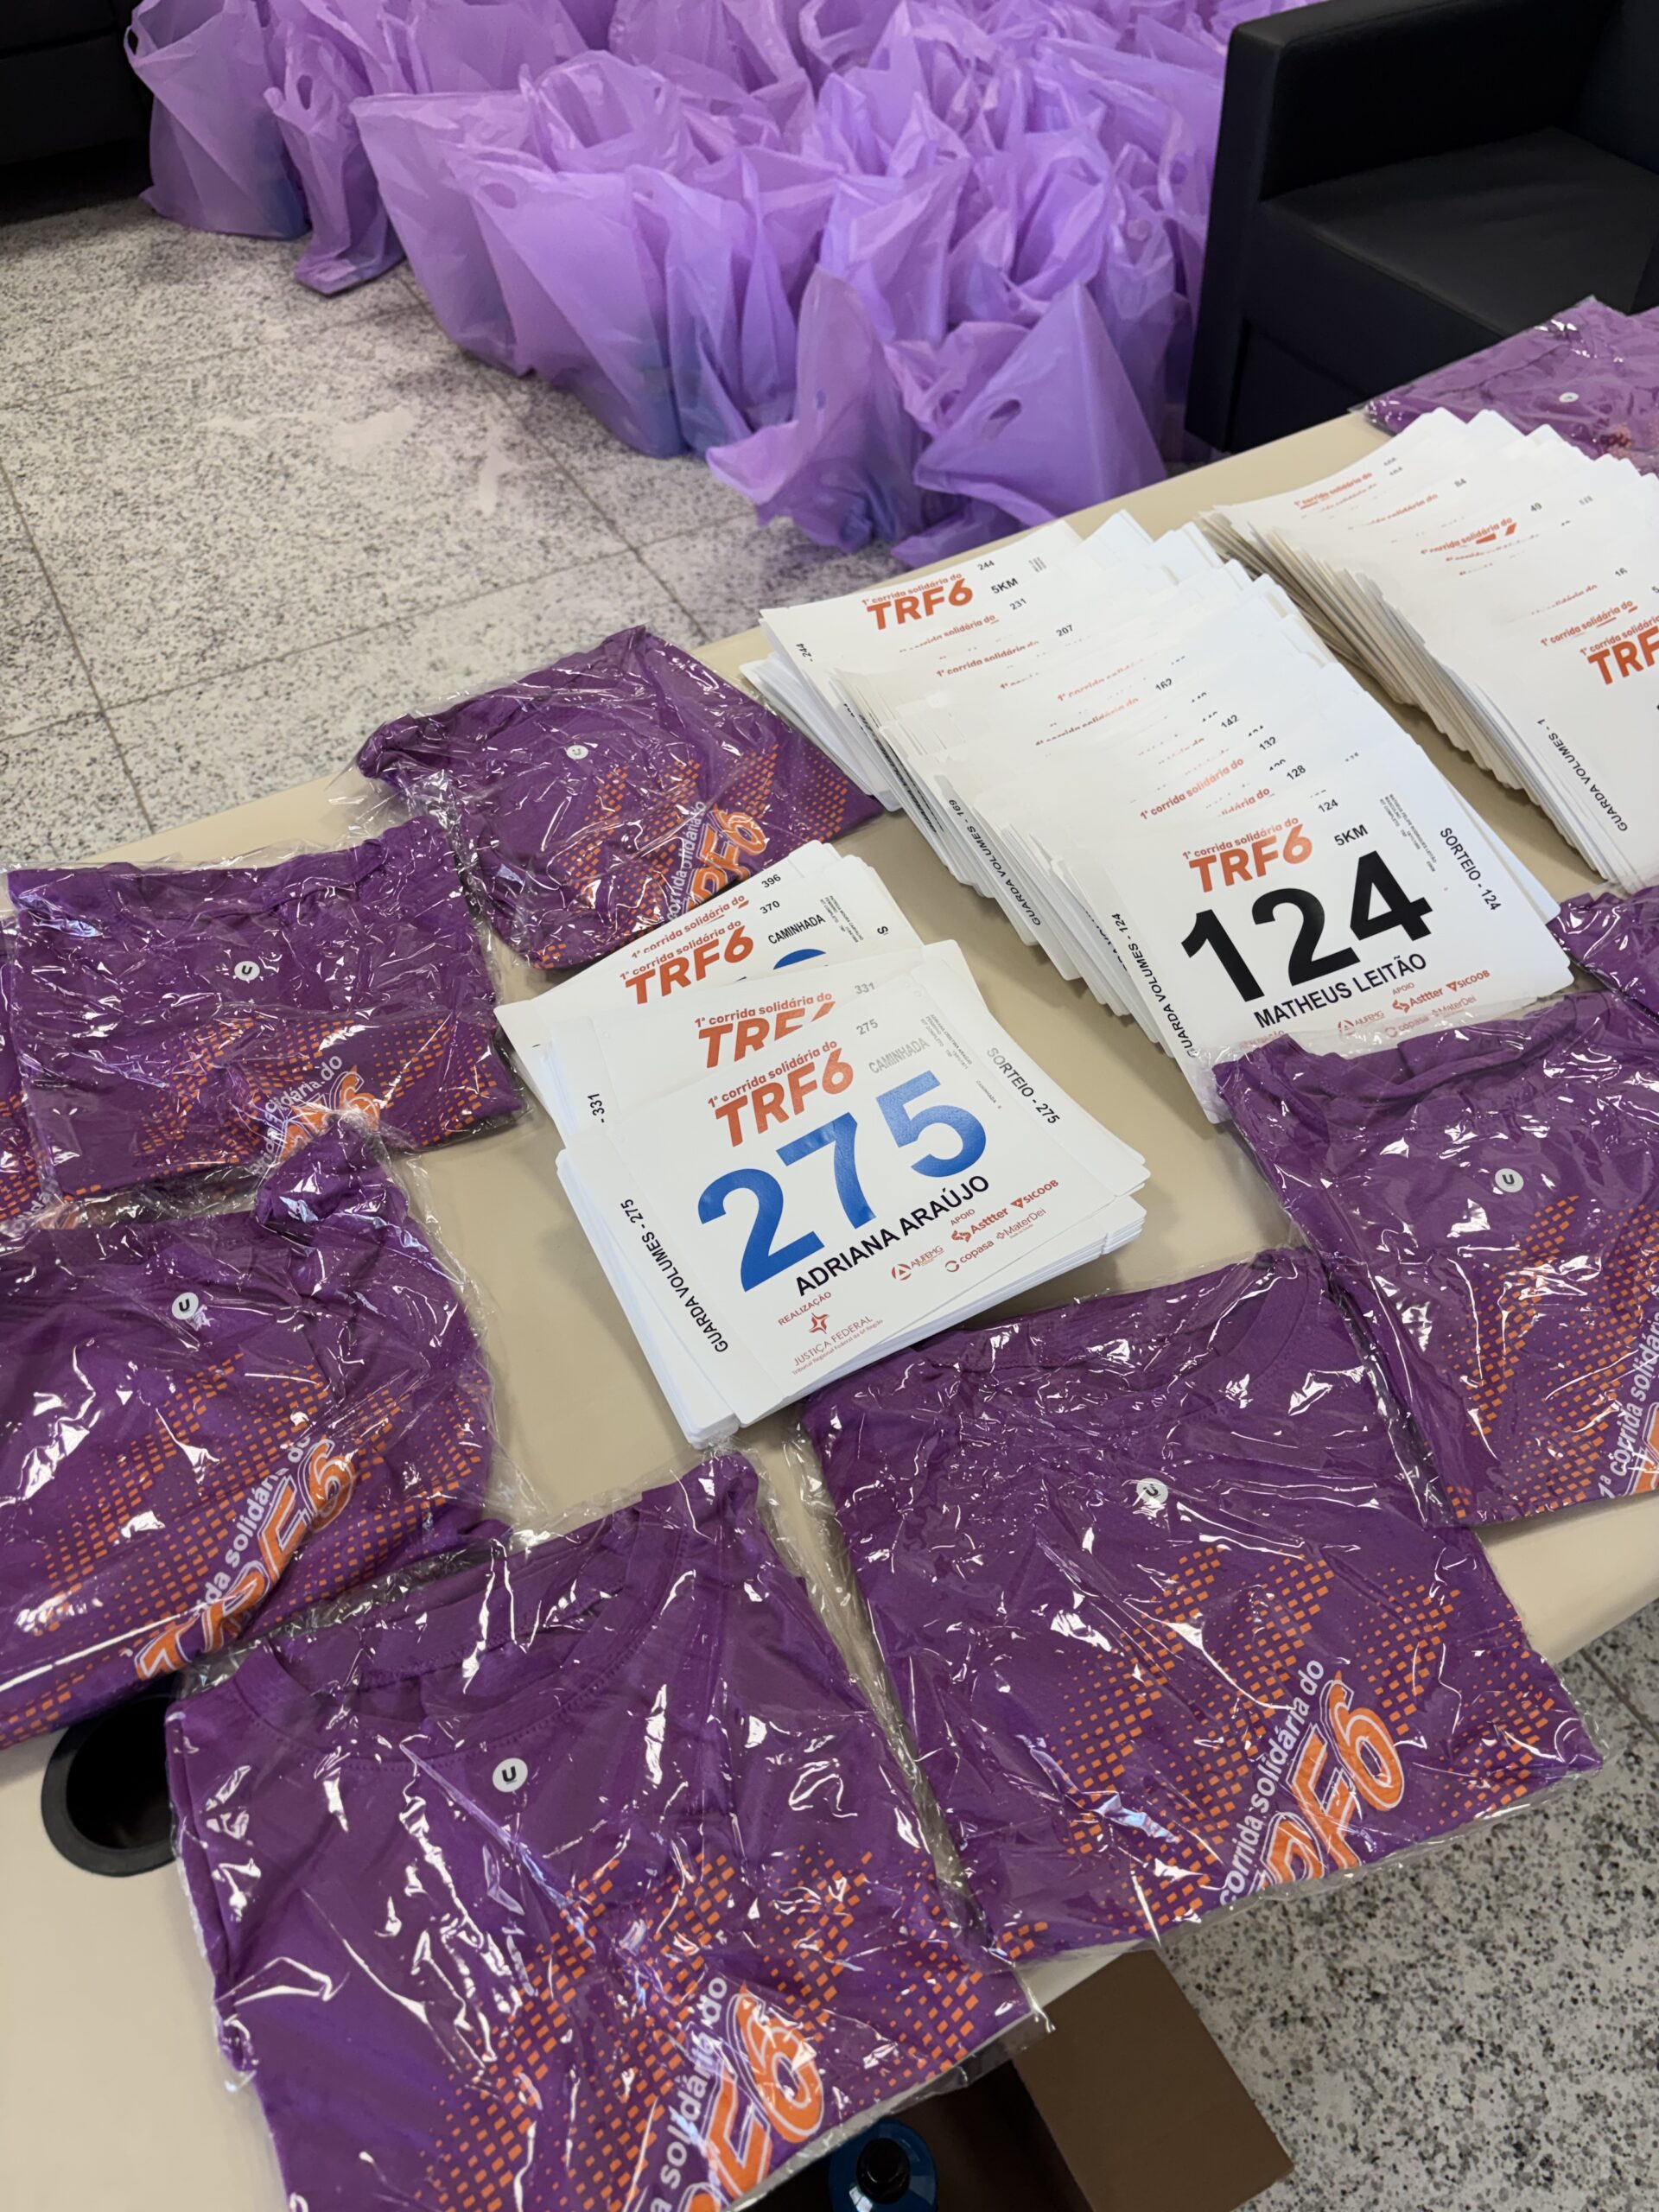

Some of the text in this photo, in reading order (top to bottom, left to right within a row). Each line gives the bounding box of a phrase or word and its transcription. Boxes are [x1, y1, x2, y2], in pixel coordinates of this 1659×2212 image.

[1459, 522, 1501, 544] solidária
[1500, 516, 1514, 527] do
[977, 559, 995, 571] 244
[872, 588, 906, 604] corrida
[907, 576, 949, 594] solidária
[950, 572, 962, 582] do
[990, 576, 1019, 595] 5KM
[866, 576, 974, 631] TRF6
[1009, 597, 1027, 612] 231
[943, 613, 996, 639] solidária do
[1055, 623, 1075, 638] 207
[1550, 625, 1582, 645] corrida
[1581, 605, 1622, 631] solidária
[1620, 599, 1634, 611] do
[1589, 633, 1623, 654] corrida
[946, 658, 983, 676] corrida
[983, 644, 1026, 664] solidária
[1220, 713, 1240, 729] 142
[1258, 735, 1277, 752] 132
[1548, 732, 1592, 785] VOLUMES
[1150, 792, 1186, 817] corrida
[1185, 766, 1231, 798] solidária
[1230, 757, 1245, 772] do
[1286, 764, 1307, 781] 128
[1255, 785, 1271, 802] do
[1317, 798, 1339, 814] 124
[1589, 784, 1629, 832] GUARDA
[1193, 838, 1234, 859] corrida
[1234, 823, 1279, 846] solidária
[1280, 816, 1300, 831] do
[1333, 823, 1369, 848] 5KM
[948, 798, 1041, 926] GUARDA VOLUMES 169
[1188, 823, 1313, 893] TRF6
[1440, 827, 1482, 881] SORTEIO
[1481, 888, 1503, 911] 124
[760, 873, 782, 890] 396
[760, 899, 781, 915] 370
[1111, 912, 1129, 934] 124
[643, 928, 683, 955] corrida
[683, 904, 730, 934] solidária
[730, 894, 746, 909] do
[767, 913, 827, 945] CAMINHADA
[1180, 850, 1433, 1003] 124
[632, 950, 676, 976] corrida
[676, 925, 727, 957] solidária
[726, 918, 742, 933] do
[625, 925, 754, 1005] TRF6
[1128, 942, 1166, 1003] VOLUMES
[1455, 969, 1491, 989] SICOOB
[854, 981, 876, 995] 331
[1253, 952, 1427, 1029] MATHEUS LEITÃO
[1391, 981, 1416, 995] APOIO
[709, 1008, 757, 1026] corrida
[758, 995, 815, 1016] solidária
[816, 991, 833, 1002] do
[855, 1018, 880, 1036] 275
[320, 1055, 343, 1082] do
[721, 1074, 767, 1103] corrida
[767, 1047, 822, 1080] solidária
[821, 1040, 838, 1053] do
[868, 1037, 931, 1074] CAMINHADA
[714, 1046, 855, 1148] TRF6
[986, 1046, 1035, 1098] SORTEIO
[1035, 1102, 1061, 1125] 275
[586, 1092, 606, 1117] 331
[696, 1070, 988, 1294] 275
[1022, 1179, 1059, 1205] SICOOB
[619, 1198, 645, 1225] 275
[950, 1208, 976, 1227] APOIO
[969, 1207, 1009, 1235] Asttter
[1002, 1206, 1048, 1236] MaterDei
[795, 1174, 990, 1297] ADRIANA ARAÚJO
[959, 1239, 995, 1264] copasa
[640, 1230, 690, 1299] VOLUMES
[684, 1294, 729, 1354] GUARDA
[777, 1291, 832, 1326] REALIZAÇÃO
[793, 1315, 874, 1367] JUSTIÇA FEDERAL
[1609, 1402, 1644, 1477] corrida
[1219, 1659, 1325, 1907] corrida solidária do
